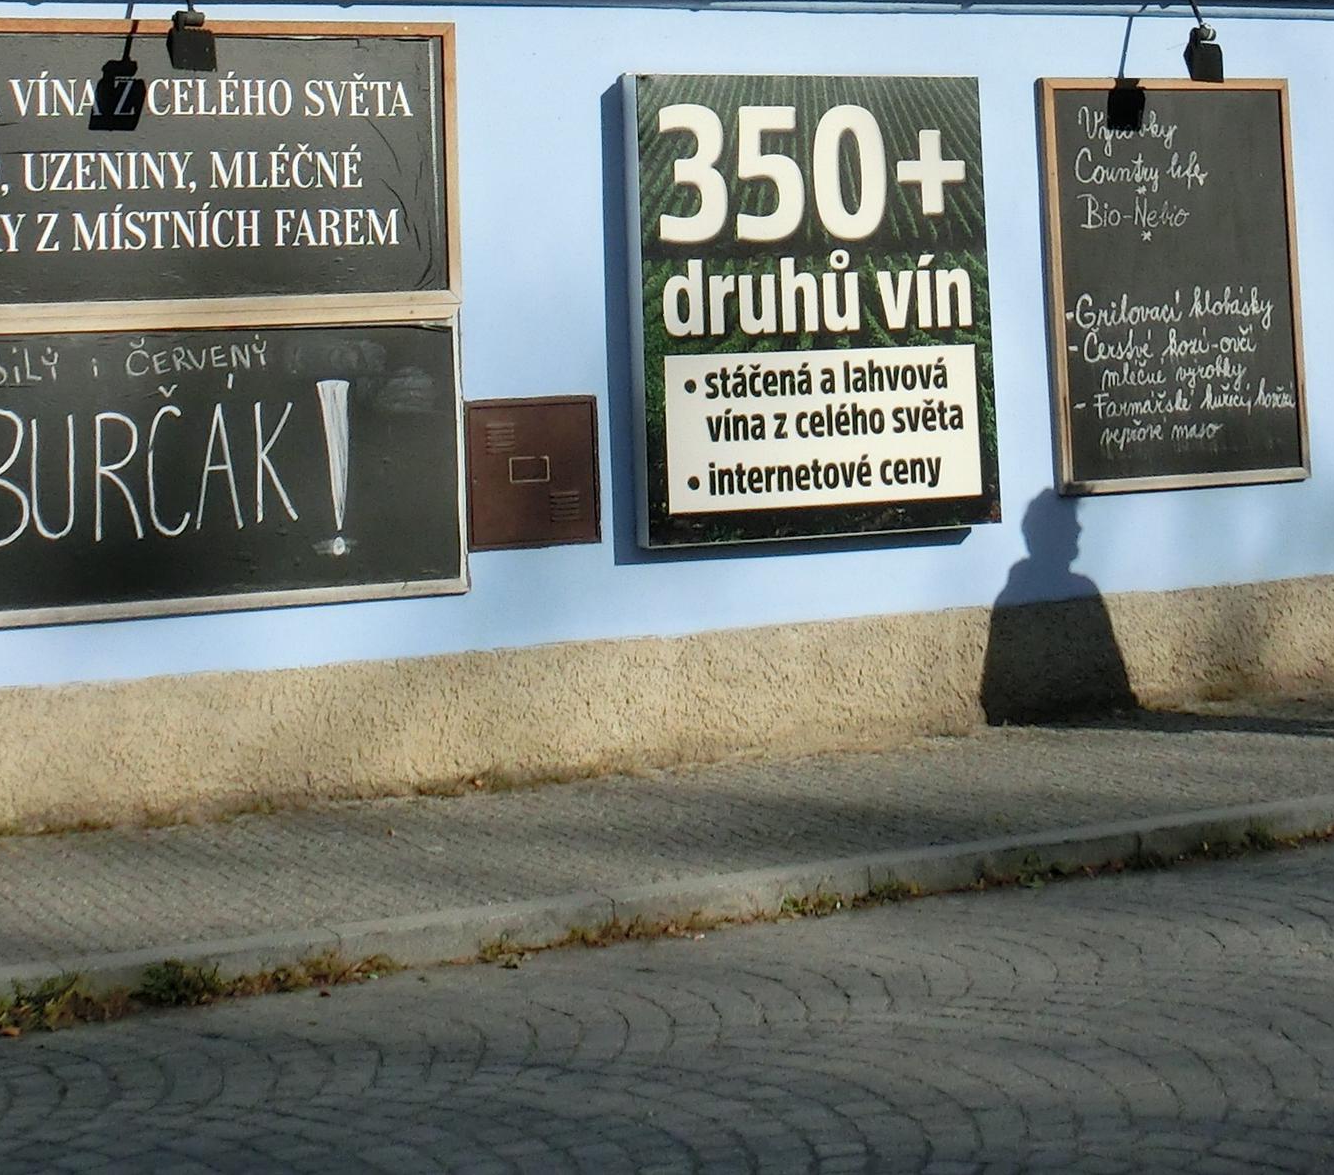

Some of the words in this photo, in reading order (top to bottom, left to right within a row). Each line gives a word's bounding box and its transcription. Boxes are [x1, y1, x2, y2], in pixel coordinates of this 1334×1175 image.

[9, 70, 103, 118] VÍNA
[113, 76, 136, 115] Z
[148, 70, 293, 118] CELÉHO
[304, 70, 413, 118] SVĚTA
[23, 149, 198, 194] UZENINY,
[209, 142, 363, 190] MLÉČNÉ
[658, 103, 966, 243] 350+
[1075, 147, 1159, 192] Country
[1167, 151, 1208, 190] life
[37, 213, 60, 252] Z
[72, 201, 261, 251] MÍSTNÍCH
[275, 207, 401, 248] FAREM
[662, 250, 861, 337] druhů
[876, 254, 973, 330] vín
[1189, 286, 1274, 330] klobásky
[1084, 326, 1153, 363] Čerstvé
[705, 363, 811, 400] stáčená
[820, 369, 836, 394] a
[843, 357, 948, 392] lahvová
[1101, 358, 1167, 391] mléčné
[707, 407, 766, 442] vína
[774, 414, 787, 439] z
[796, 403, 884, 438] celého
[892, 399, 964, 434] světa
[1093, 388, 1192, 419] Farmářské
[1100, 417, 1164, 451] vepřové
[1171, 422, 1224, 441] maso
[709, 454, 871, 496] internetové
[880, 454, 942, 489] ceny
